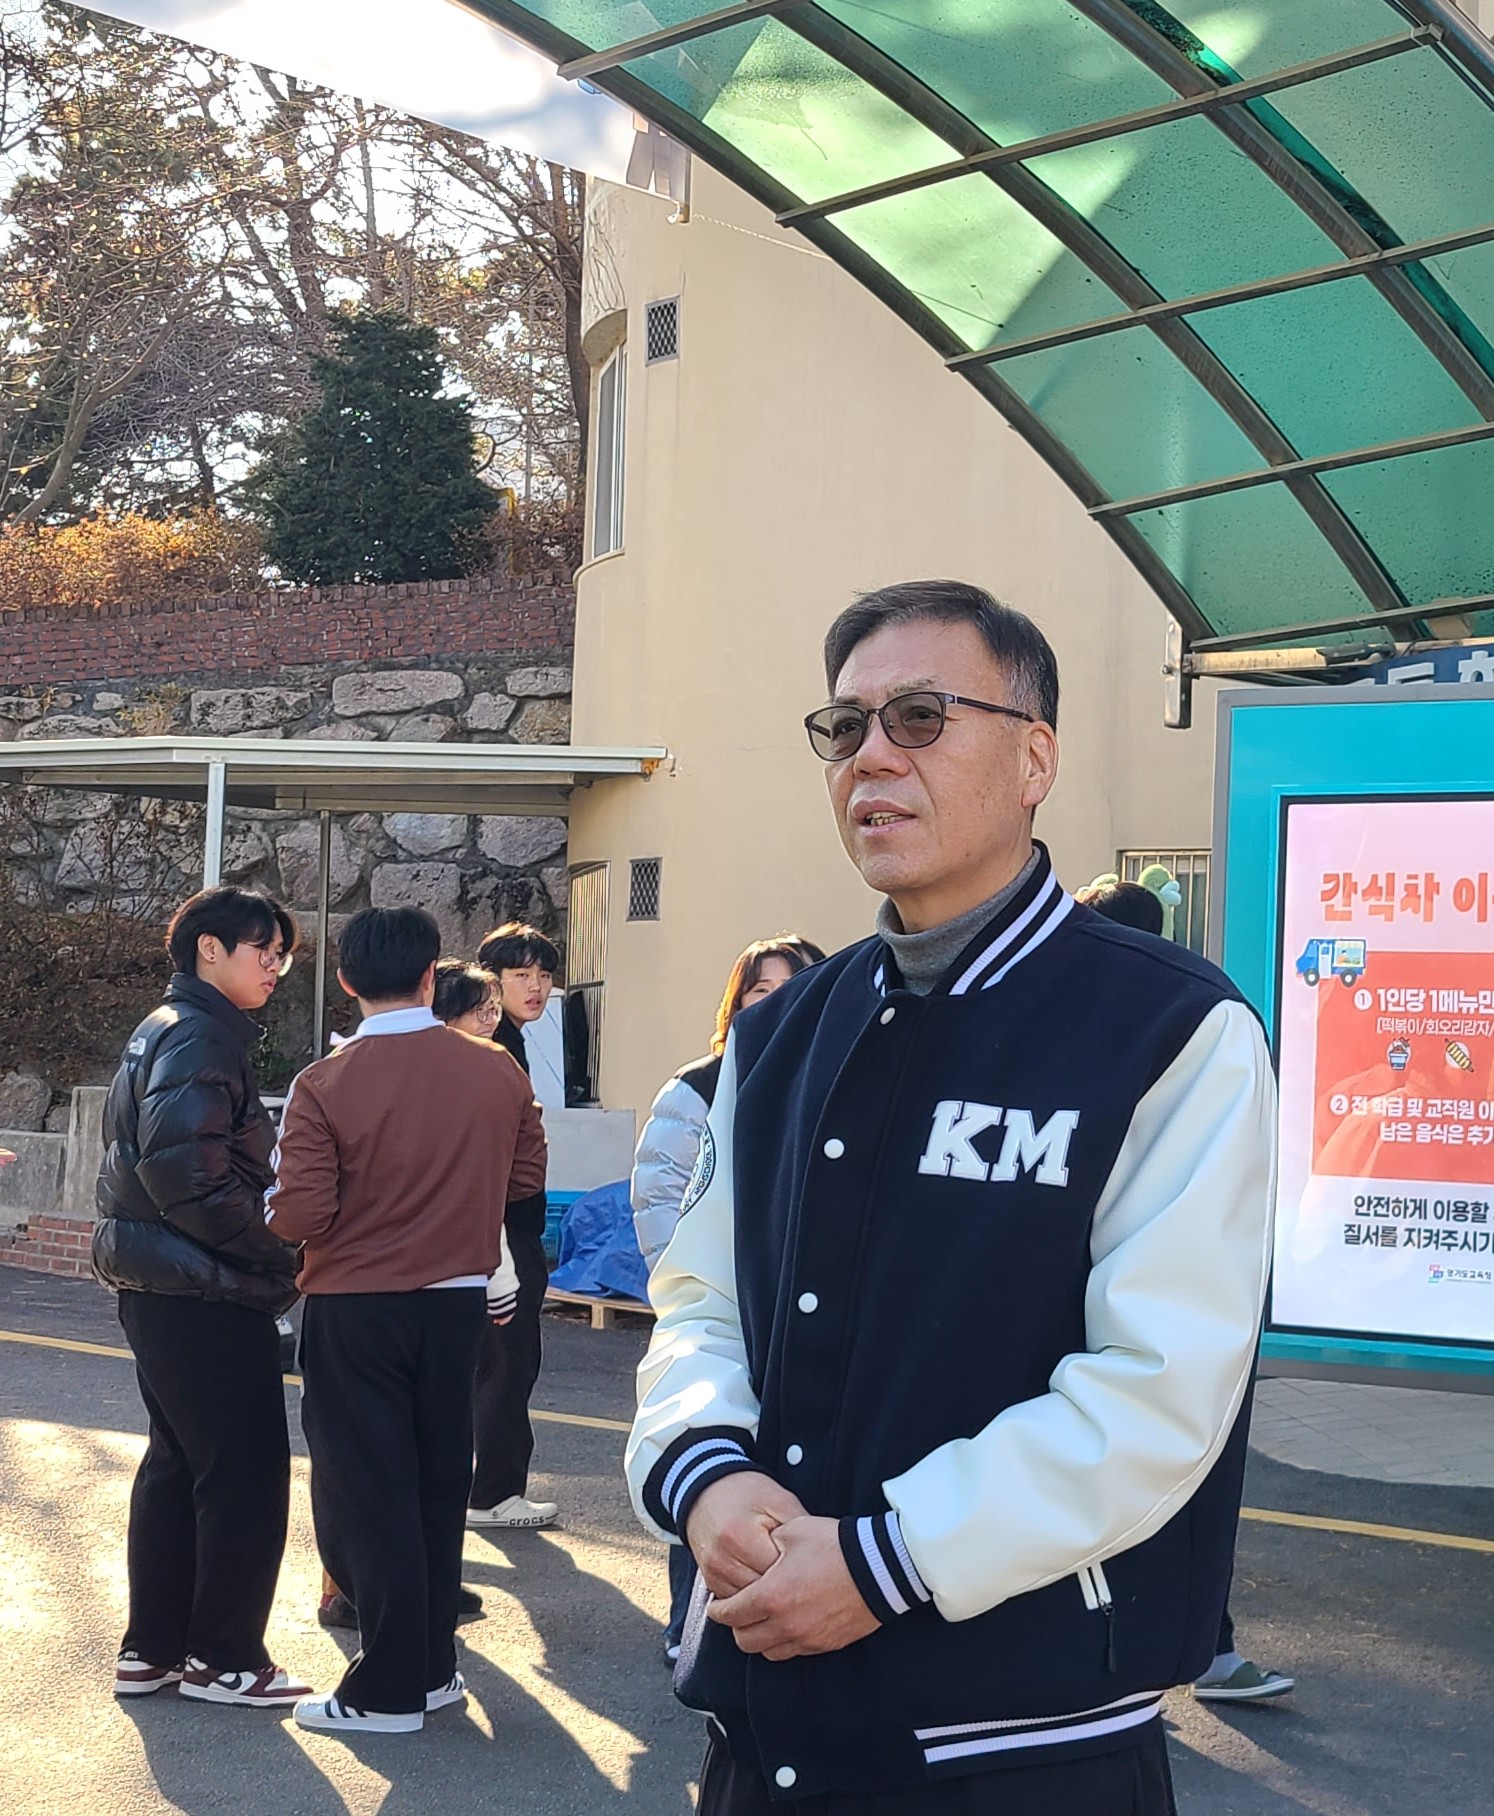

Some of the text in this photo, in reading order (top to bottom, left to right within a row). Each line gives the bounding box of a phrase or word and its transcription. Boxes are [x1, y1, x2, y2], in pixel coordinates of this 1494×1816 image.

[1320, 872, 1440, 923] 간식차
[1376, 988, 1426, 1012] 1인당
[1351, 1095, 1368, 1115] 전
[1406, 1098, 1423, 1117] 및
[1426, 1099, 1476, 1120] 교직원
[918, 1100, 1081, 1187] KM
[1380, 1122, 1413, 1142] 남은
[1415, 1124, 1464, 1144] 음식은
[1354, 1195, 1428, 1220] 안전하게
[1433, 1200, 1489, 1223] 이용할
[1343, 1223, 1398, 1247] 질서를
[509, 1516, 545, 1526] crocs
